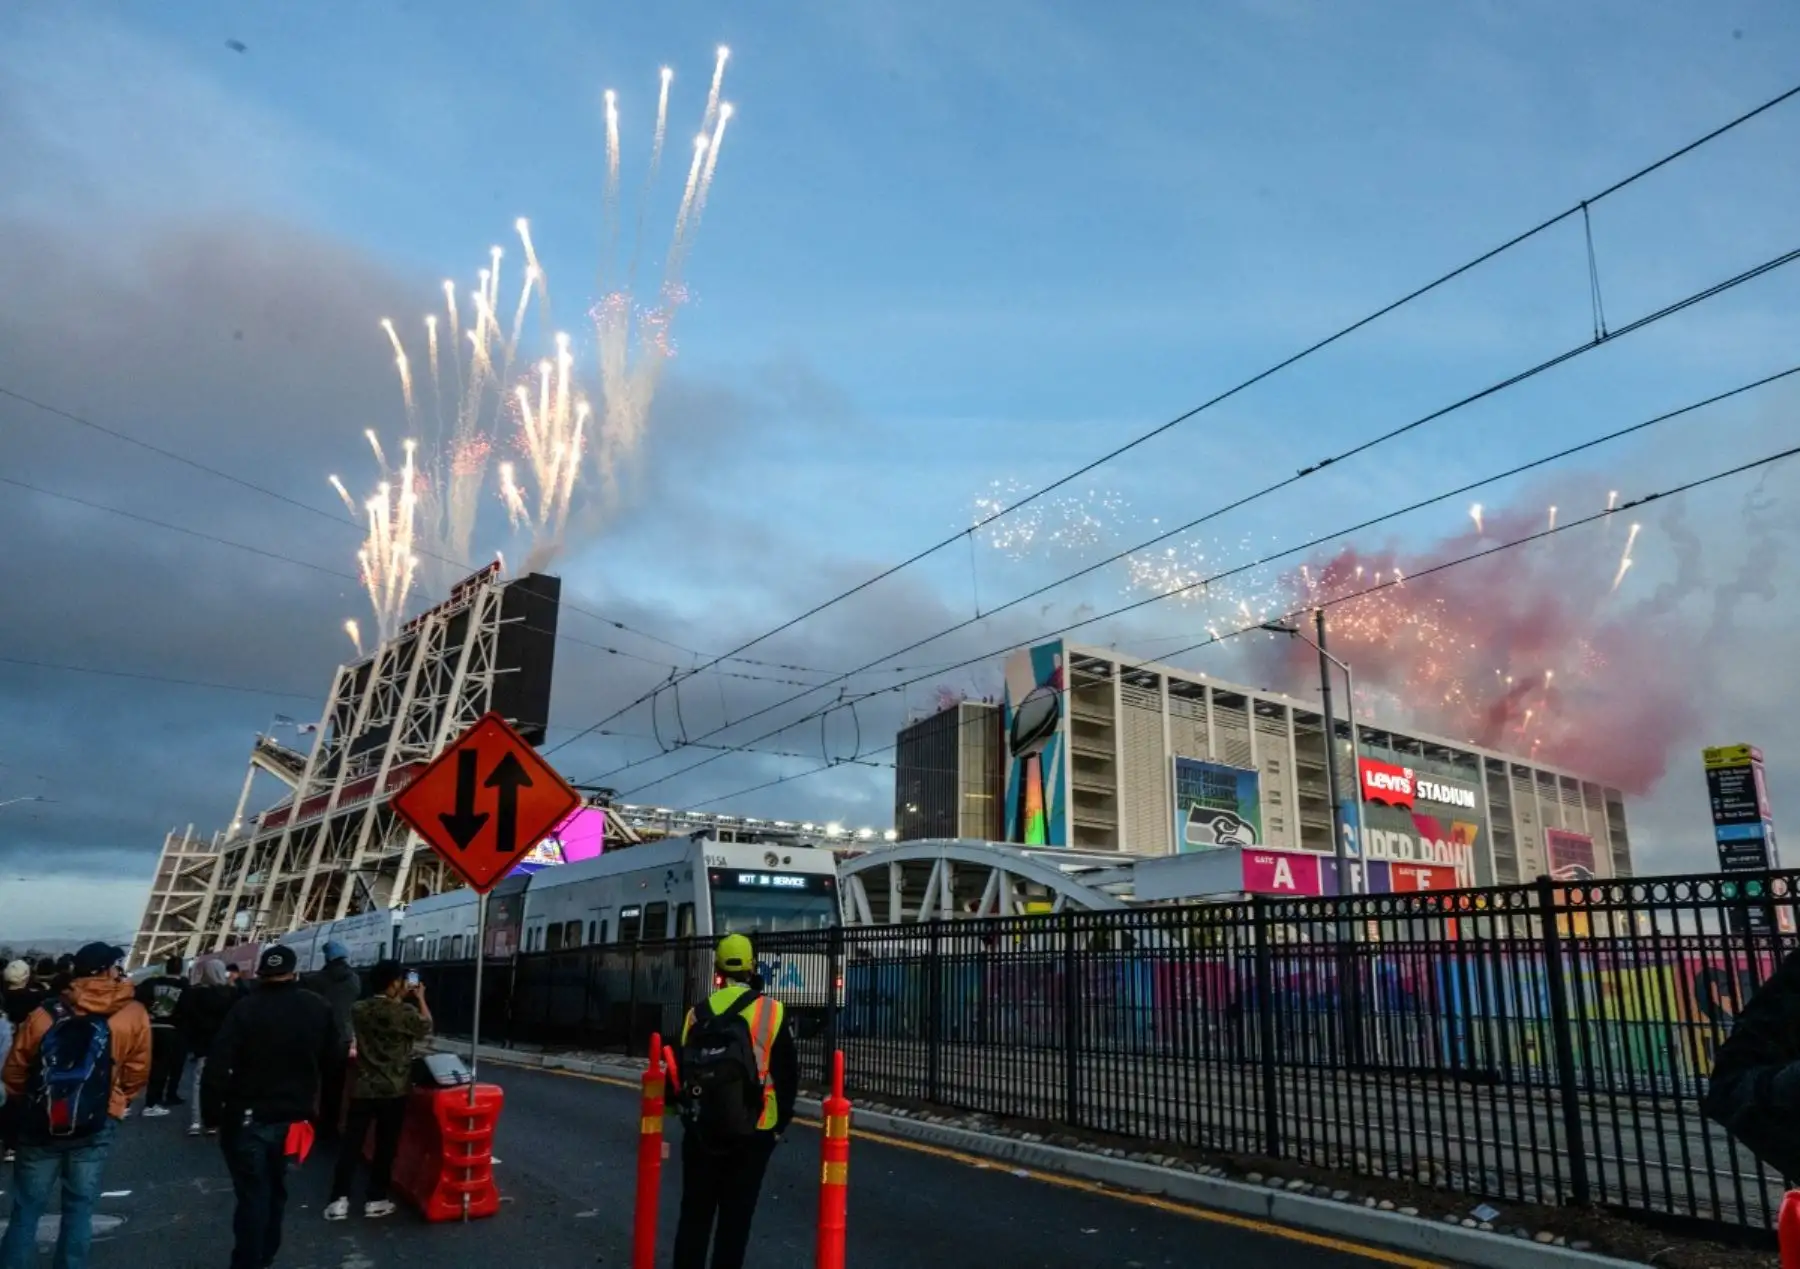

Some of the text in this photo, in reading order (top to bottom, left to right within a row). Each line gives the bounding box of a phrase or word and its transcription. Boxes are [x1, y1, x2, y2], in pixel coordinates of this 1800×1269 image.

[1417, 780, 1475, 808] STADIUM
[738, 873, 756, 885] NOT
[773, 876, 805, 888] SERVICE
[1272, 857, 1296, 889] A
